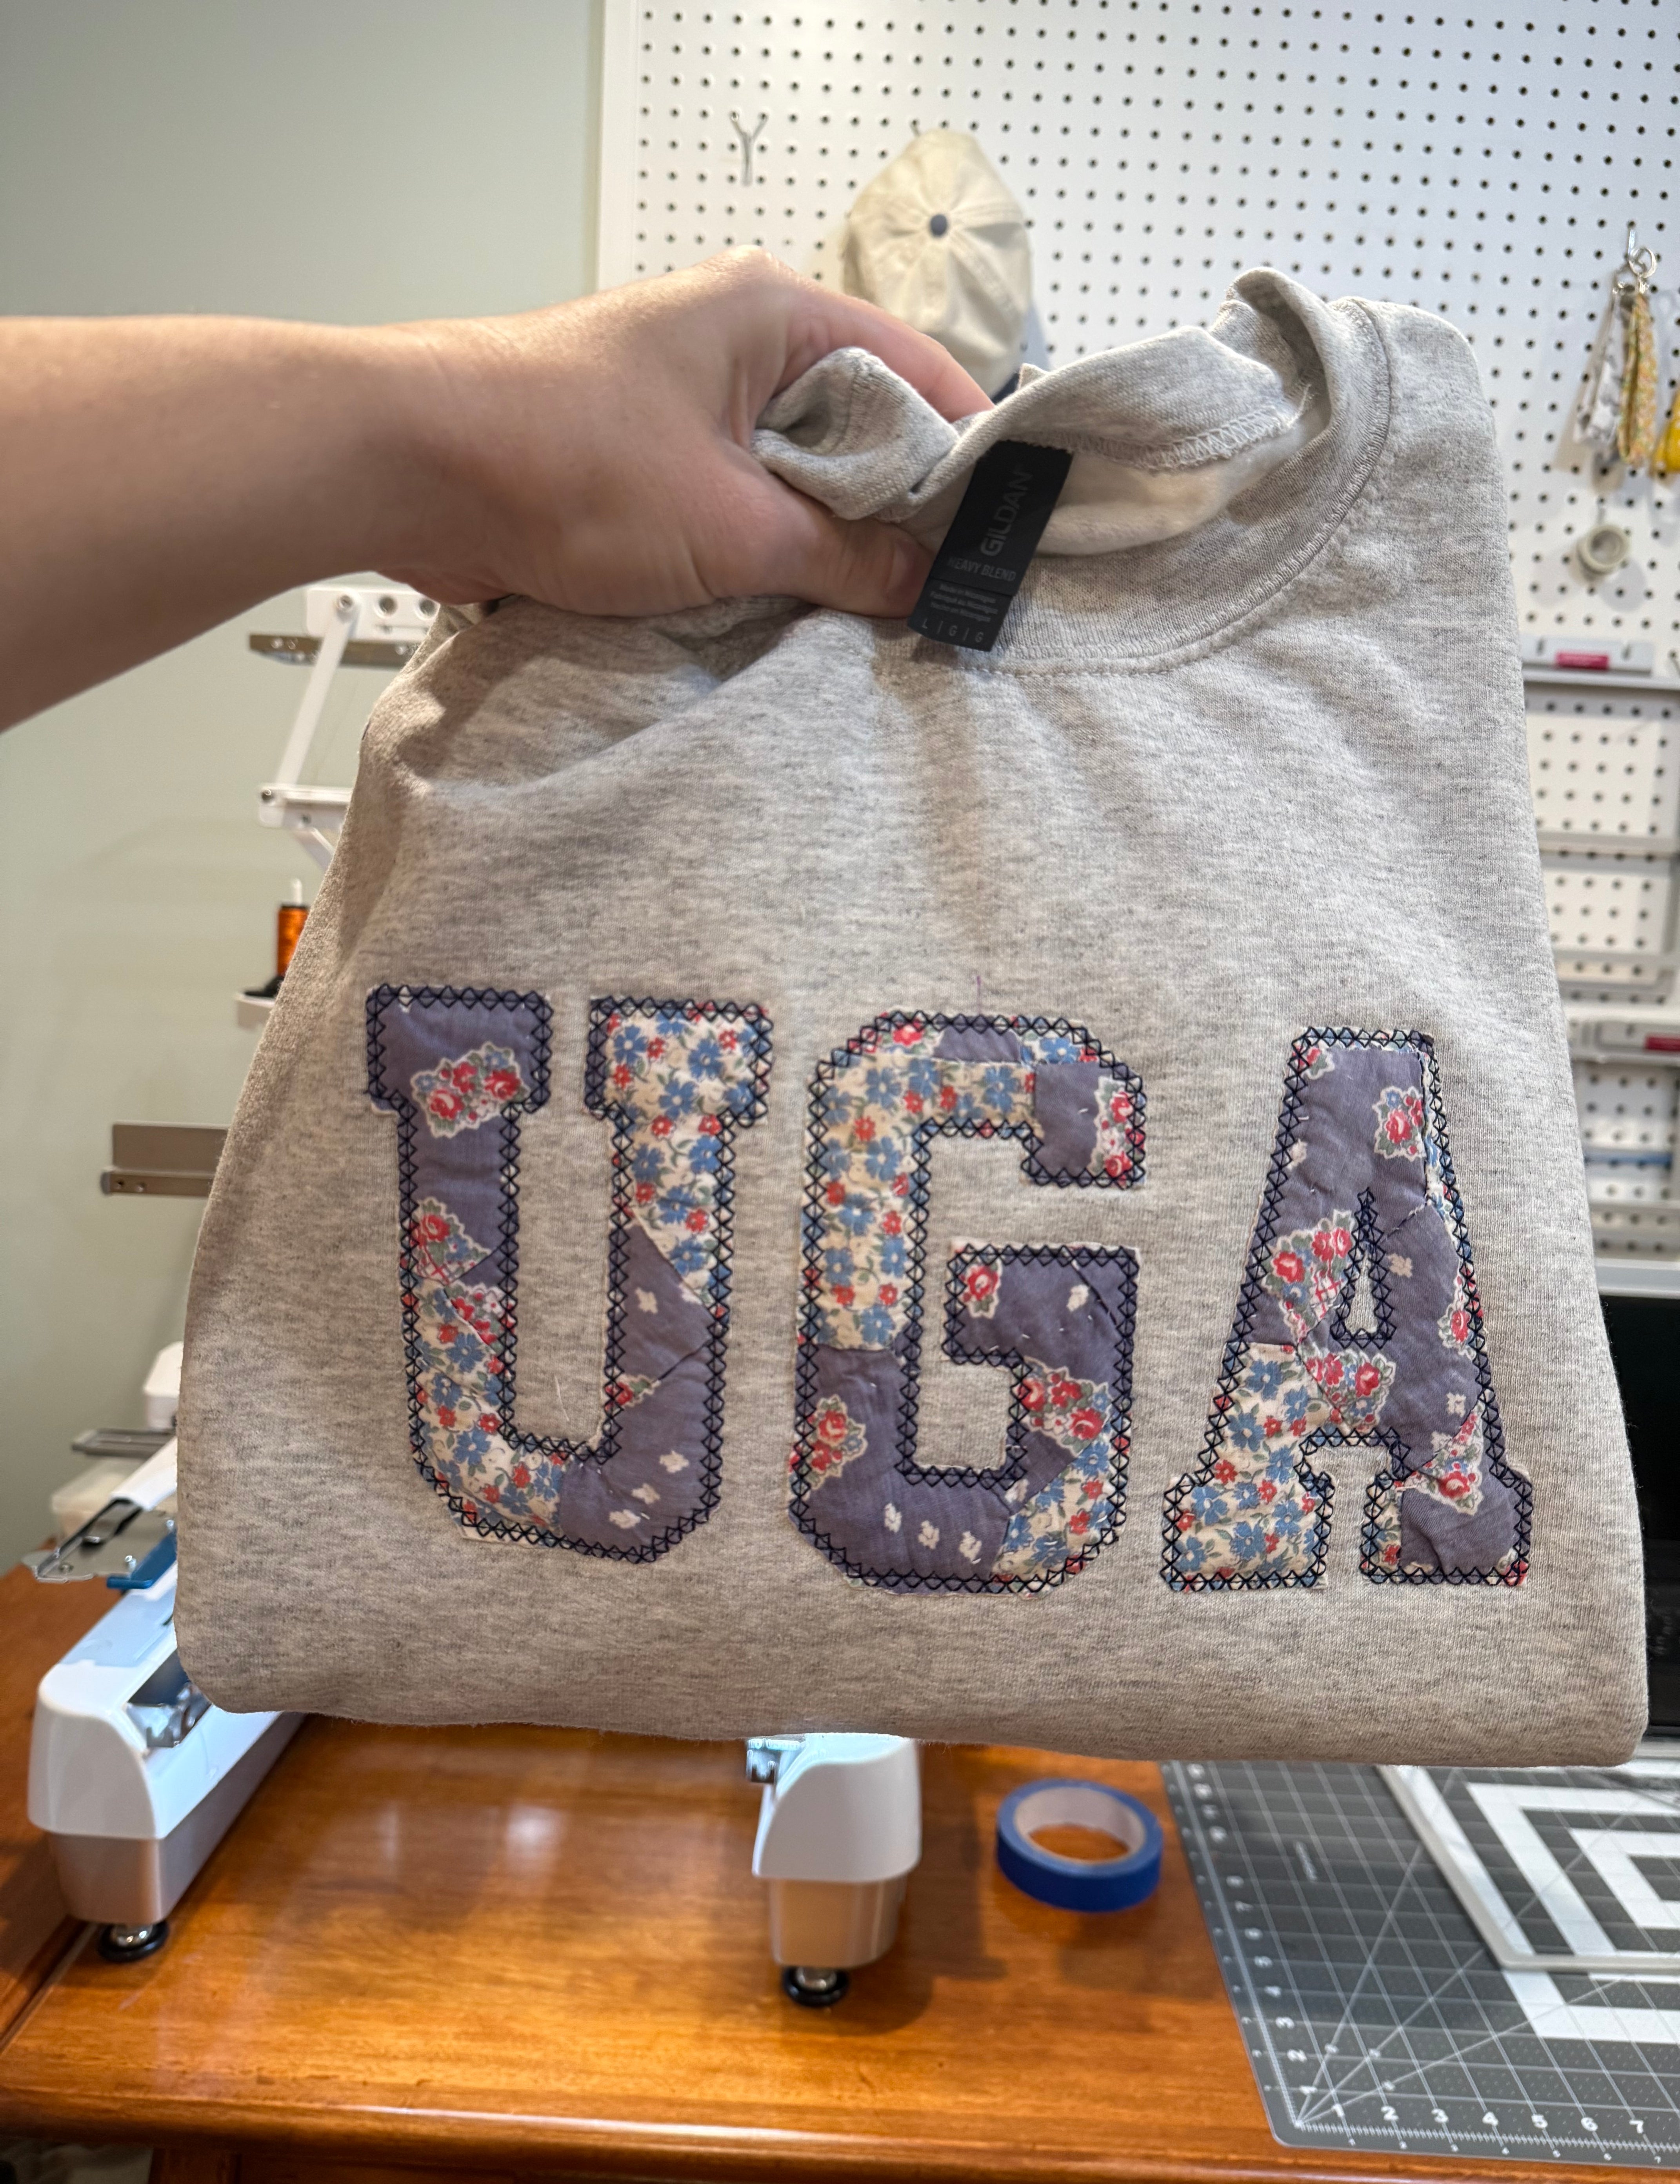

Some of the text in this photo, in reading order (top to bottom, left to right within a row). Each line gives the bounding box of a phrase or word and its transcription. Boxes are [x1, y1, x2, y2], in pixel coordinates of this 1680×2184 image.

[980, 471, 1033, 556] GILDAN
[947, 556, 1016, 582] HEAVY BLEND
[365, 984, 1533, 1594] UGA
[1333, 2103, 1345, 2118] 1
[1380, 2105, 1399, 2122] 2
[1431, 2108, 1449, 2124] 3
[1482, 2111, 1499, 2127] 4
[1581, 2117, 1598, 2132] 6
[1629, 2119, 1644, 2134] 7
